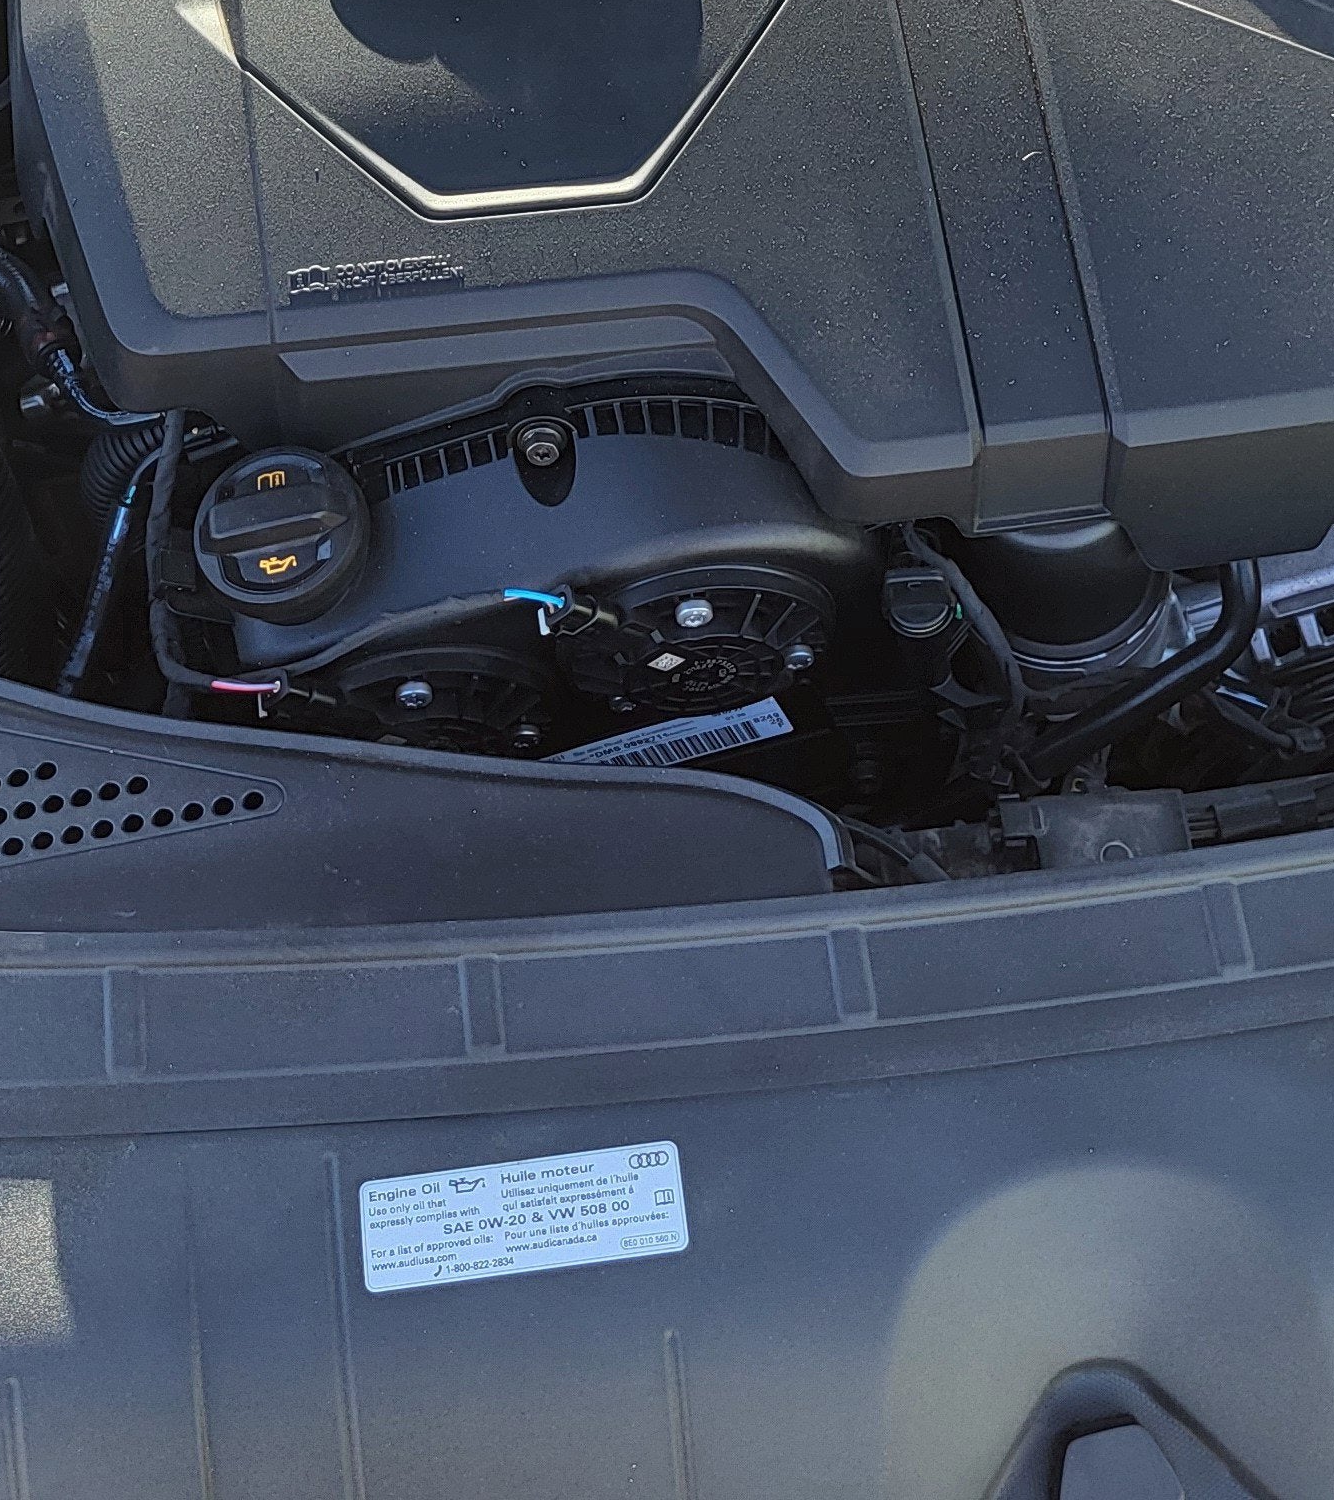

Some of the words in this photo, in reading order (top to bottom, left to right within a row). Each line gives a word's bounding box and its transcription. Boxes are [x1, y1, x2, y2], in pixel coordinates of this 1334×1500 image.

[500, 1169, 536, 1184] Huile
[540, 1162, 594, 1178] moteur
[368, 1185, 416, 1204] Engine
[421, 1182, 440, 1194] Oil
[500, 1185, 535, 1198] Utilisez
[537, 1177, 594, 1195] uniquement
[595, 1175, 607, 1185] de
[368, 1205, 387, 1216] Use
[389, 1202, 410, 1215] only
[412, 1200, 425, 1210] oil
[427, 1197, 446, 1208] that
[502, 1200, 517, 1212] qui
[520, 1194, 557, 1209] satisfait
[558, 1185, 626, 1205] expressément
[369, 1215, 413, 1231] expressly
[415, 1208, 457, 1224] complies
[459, 1205, 480, 1217] with
[443, 1220, 474, 1235] SAE
[477, 1213, 527, 1230] 0W-20
[531, 1211, 543, 1223] &
[548, 1206, 575, 1220] VW
[580, 1202, 607, 1216] 508
[611, 1199, 630, 1212] 00
[504, 1229, 526, 1241] Pour
[529, 1227, 546, 1237] une
[548, 1222, 569, 1234] liste
[370, 1248, 386, 1259] For
[389, 1248, 395, 1256] a
[397, 1244, 412, 1255] list
[414, 1243, 424, 1253] of
[426, 1236, 471, 1253] approved
[473, 1233, 493, 1244] oils:
[505, 1232, 597, 1254] www.audicanada.ca
[371, 1250, 457, 1271] www.audiusa.com
[446, 1256, 514, 1274] 1-800-822-2834
